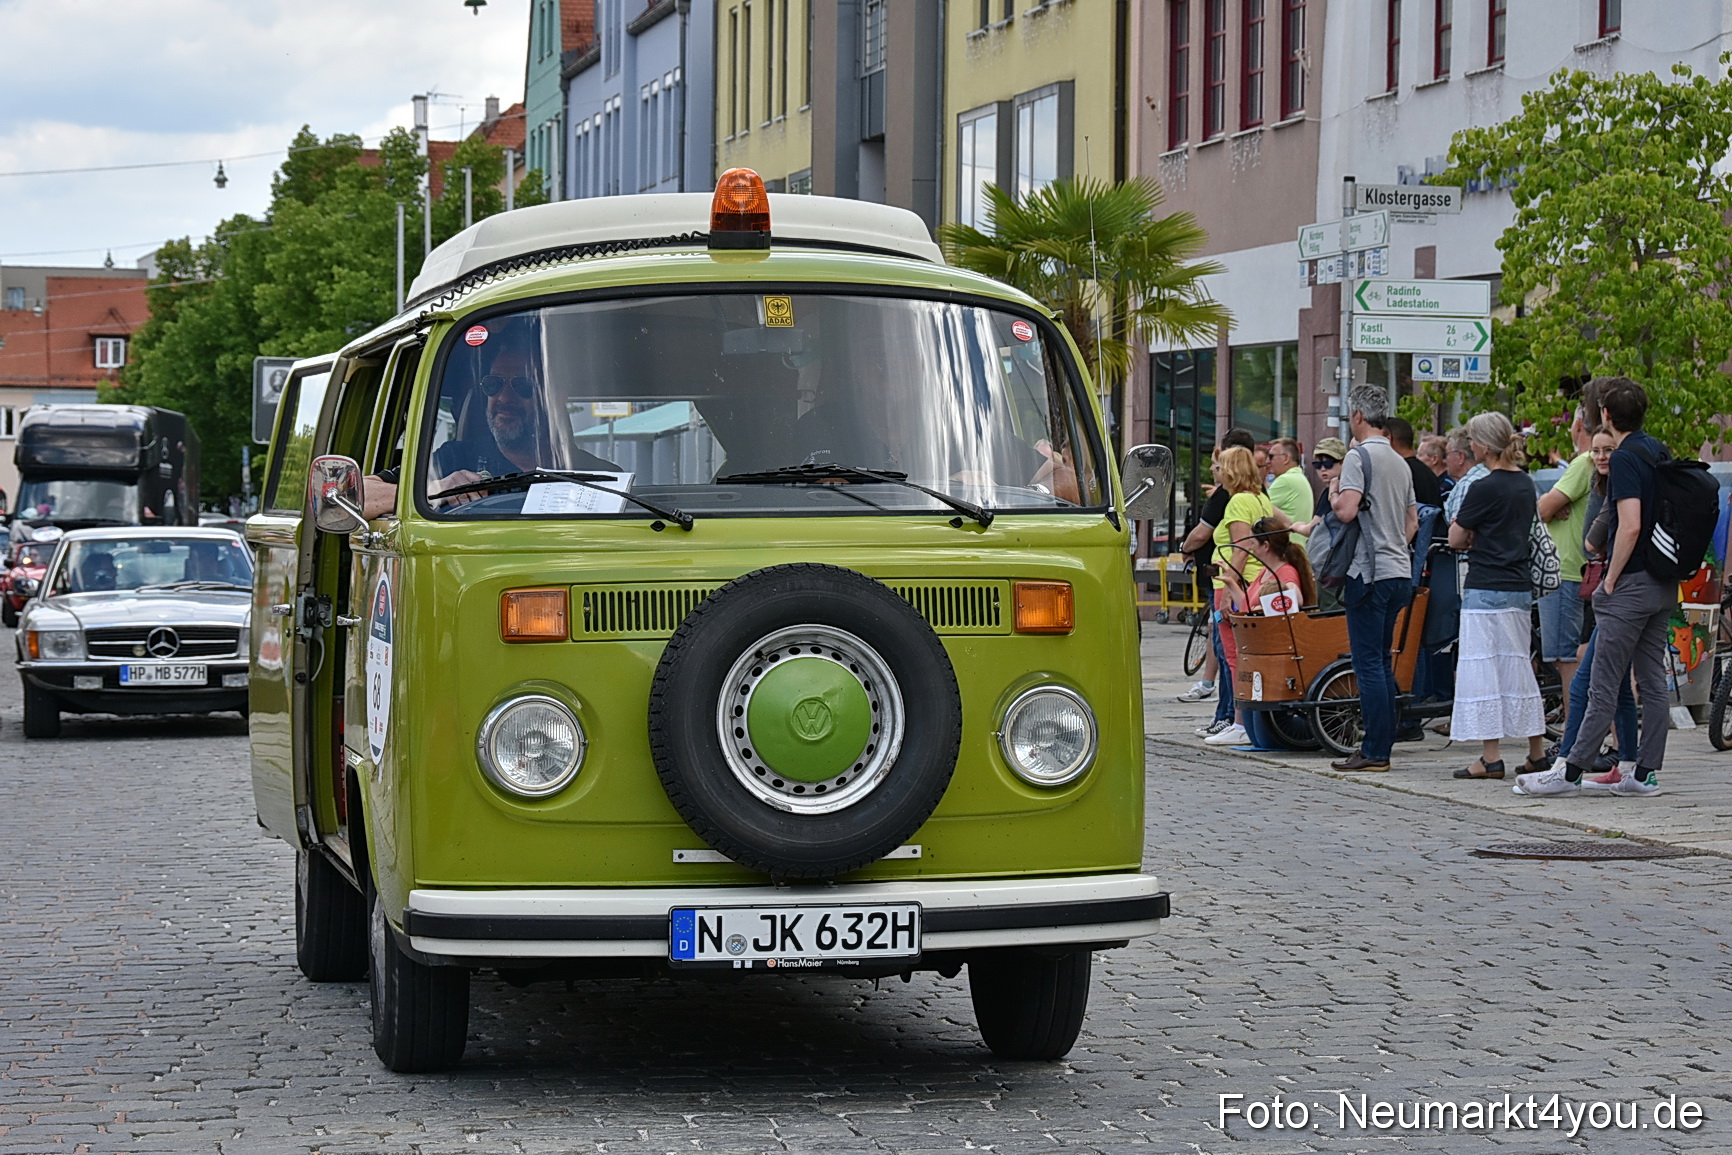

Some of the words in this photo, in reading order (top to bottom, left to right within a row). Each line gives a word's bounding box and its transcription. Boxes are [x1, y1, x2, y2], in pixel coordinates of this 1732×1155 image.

[1365, 188, 1451, 210] Klostergasse
[1386, 285, 1421, 296] Radinfo
[1386, 297, 1440, 309] Ladestation
[769, 317, 791, 325] ADAC
[1360, 322, 1383, 333] Kastl
[1446, 325, 1456, 335] 26
[1360, 334, 1391, 345] Pilsach
[129, 666, 146, 680] HP
[155, 666, 171, 680] MB
[174, 666, 205, 680] 577H
[698, 915, 723, 953] N
[753, 913, 804, 952] JK
[815, 911, 916, 951] 632H
[679, 940, 689, 952] D
